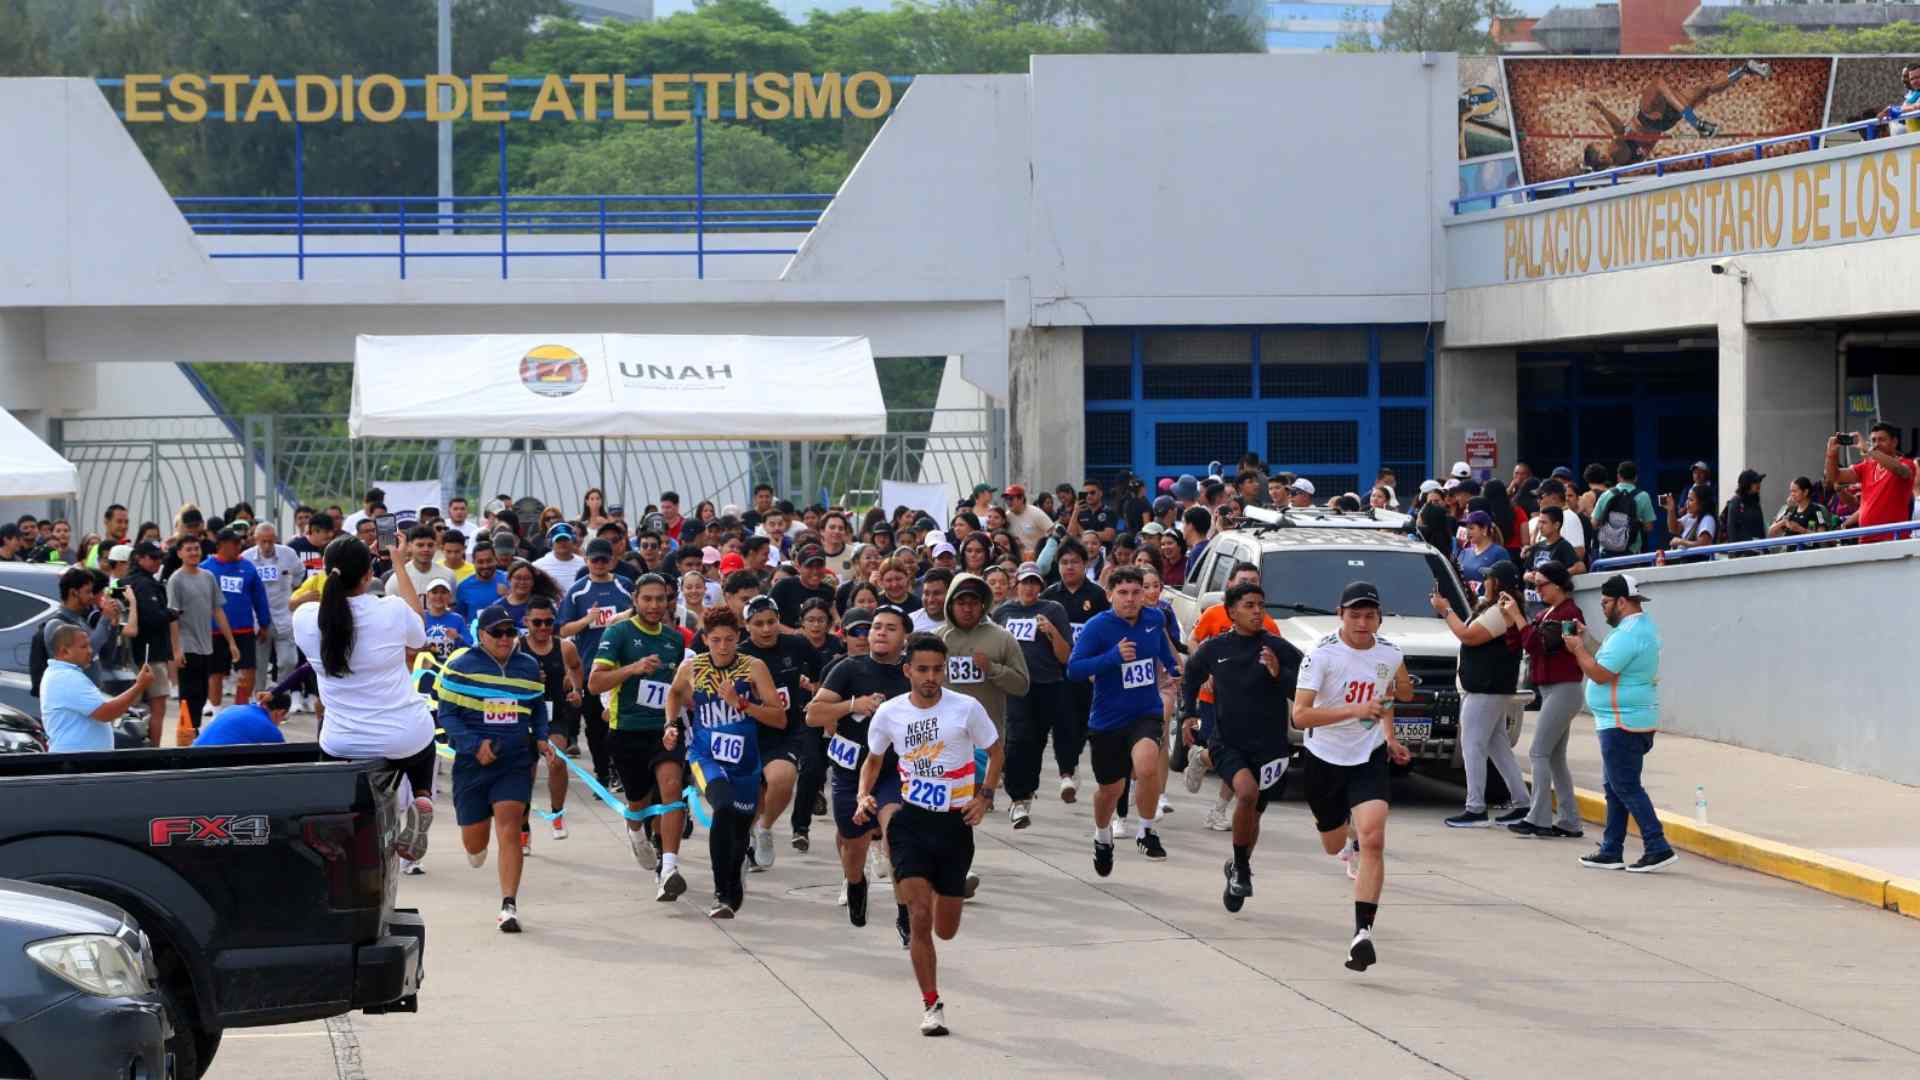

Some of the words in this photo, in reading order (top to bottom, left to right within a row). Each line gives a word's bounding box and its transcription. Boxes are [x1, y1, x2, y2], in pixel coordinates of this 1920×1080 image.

[124, 73, 407, 122] ESTADIO
[425, 73, 508, 121] DE
[529, 71, 893, 121] ATLETISMO
[1505, 206, 1592, 280] PALACIO
[1599, 174, 1784, 270] UNIVERSITARIO
[1791, 164, 1831, 245] DE
[1839, 152, 1900, 238] LOS
[619, 362, 733, 380] UNAH
[1008, 622, 1032, 638] 372
[950, 661, 983, 680] 335
[1124, 662, 1154, 684] 438
[647, 684, 665, 705] 71
[1345, 680, 1375, 704] 311
[907, 717, 938, 734] NEVER
[712, 736, 742, 760] 416
[905, 728, 940, 748] FORGET
[913, 757, 932, 771] YOU
[1263, 762, 1283, 785] 34
[909, 778, 946, 806] 226
[148, 815, 270, 846] FX4
